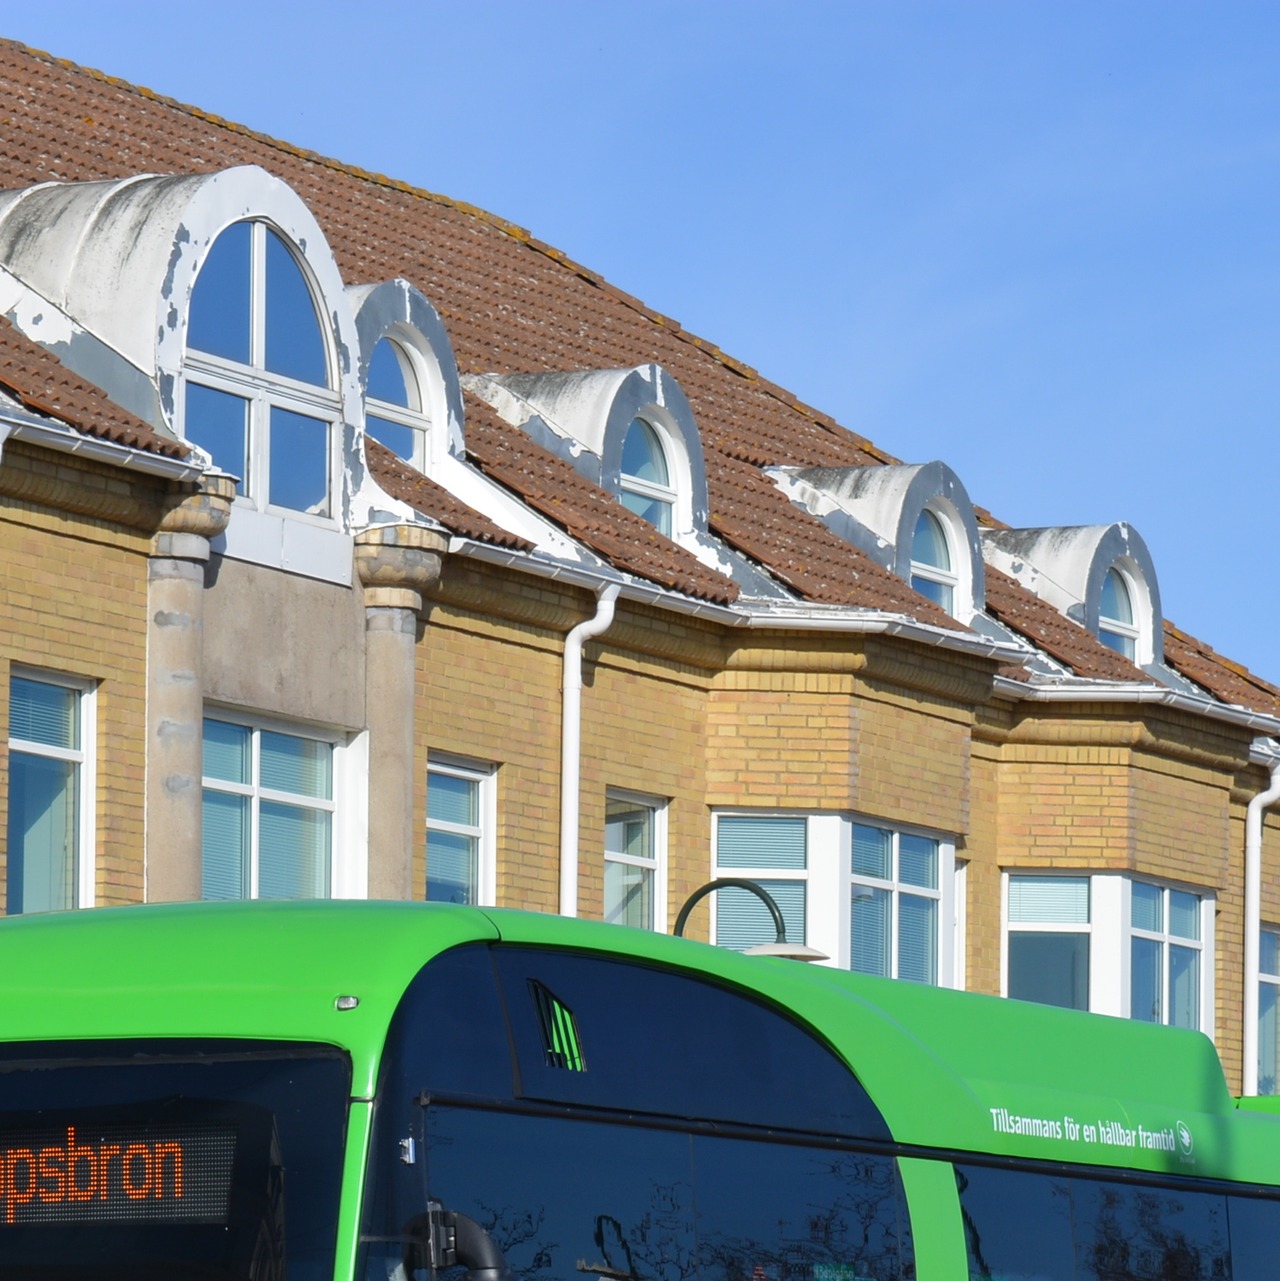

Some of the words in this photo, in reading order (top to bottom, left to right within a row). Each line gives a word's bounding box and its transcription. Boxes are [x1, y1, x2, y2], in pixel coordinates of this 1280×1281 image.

[989, 1107, 1063, 1140] Tillsammans
[1063, 1116, 1080, 1142] för
[1082, 1123, 1098, 1143] en
[1098, 1119, 1137, 1148] hållbar
[1138, 1124, 1176, 1151] framtid
